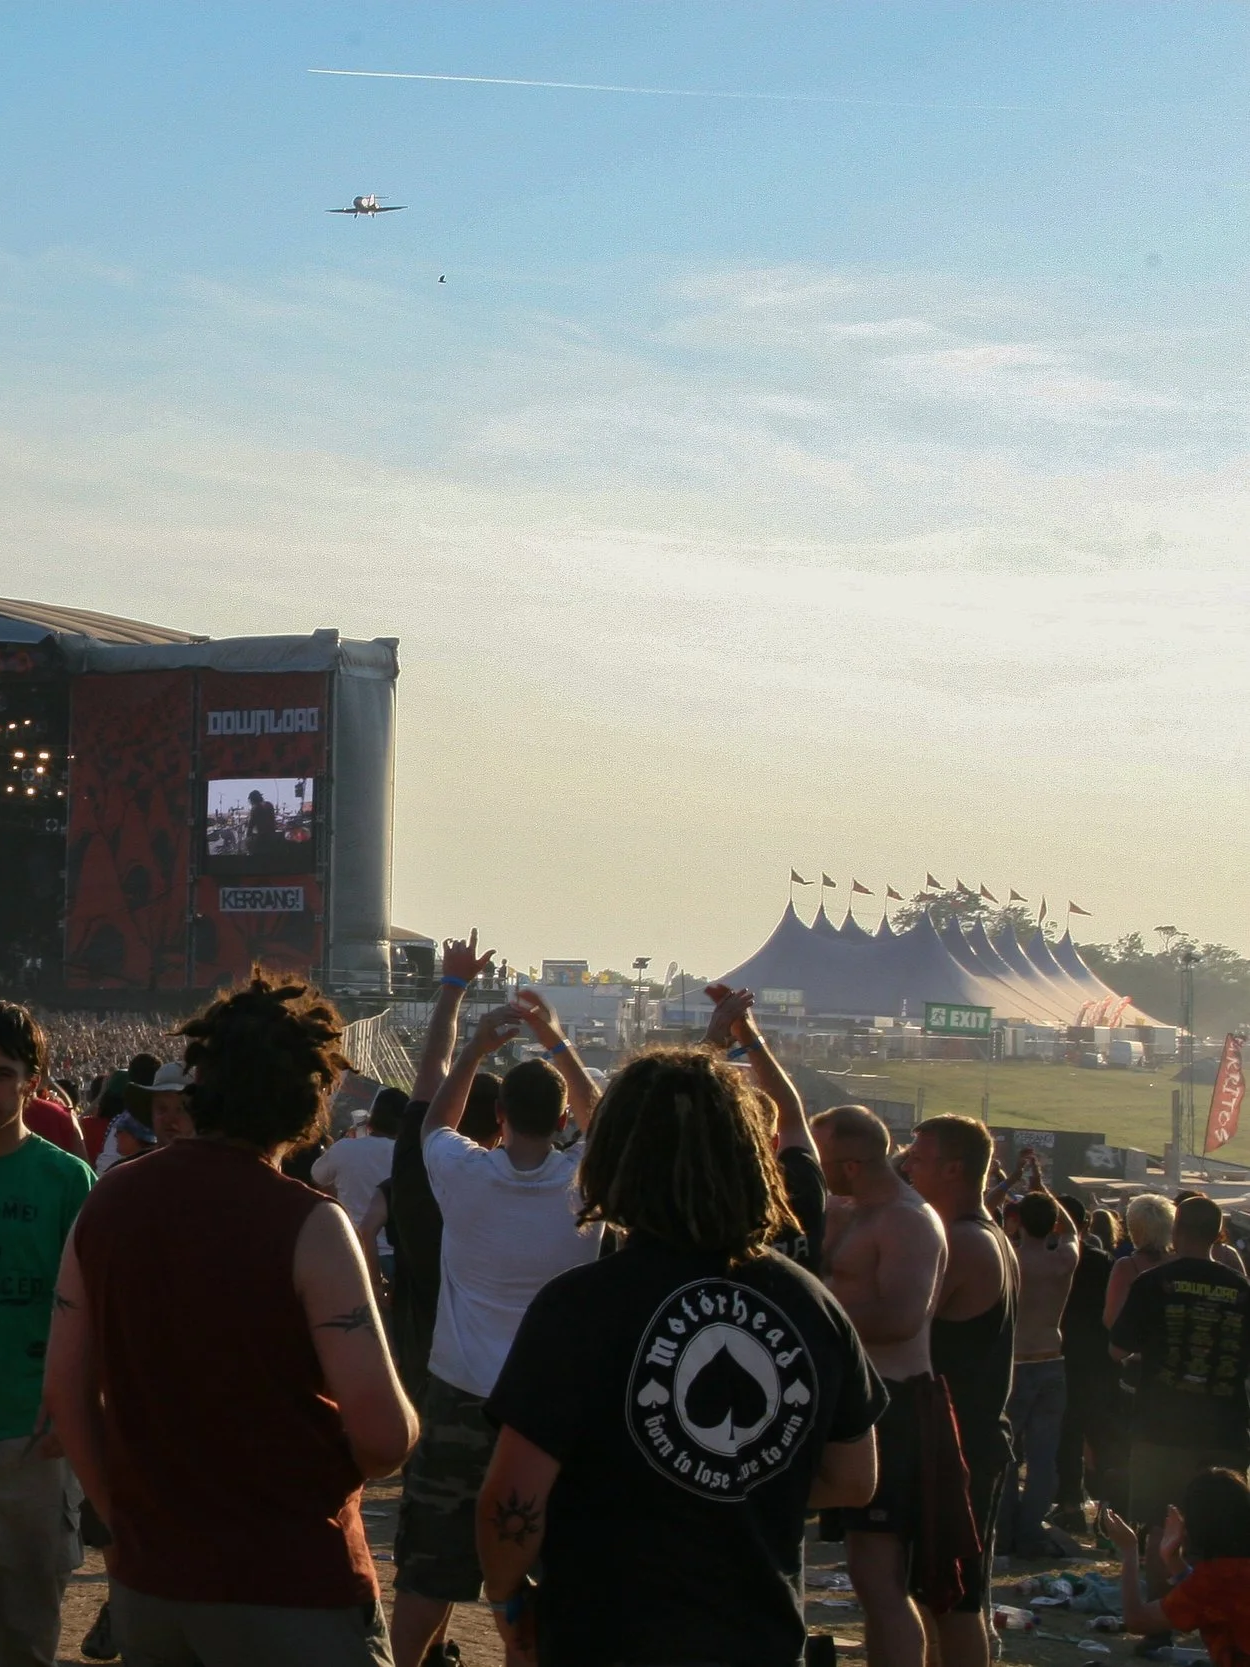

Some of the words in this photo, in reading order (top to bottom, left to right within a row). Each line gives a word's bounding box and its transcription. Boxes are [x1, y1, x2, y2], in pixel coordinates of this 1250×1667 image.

[206, 707, 319, 737] DOWNLOAD
[221, 888, 301, 910] KERRANG!
[950, 1010, 987, 1028] EXIT
[673, 1450, 691, 1474] to
[694, 1460, 730, 1489] lose
[760, 1446, 782, 1465] to
[780, 1413, 804, 1448] win
